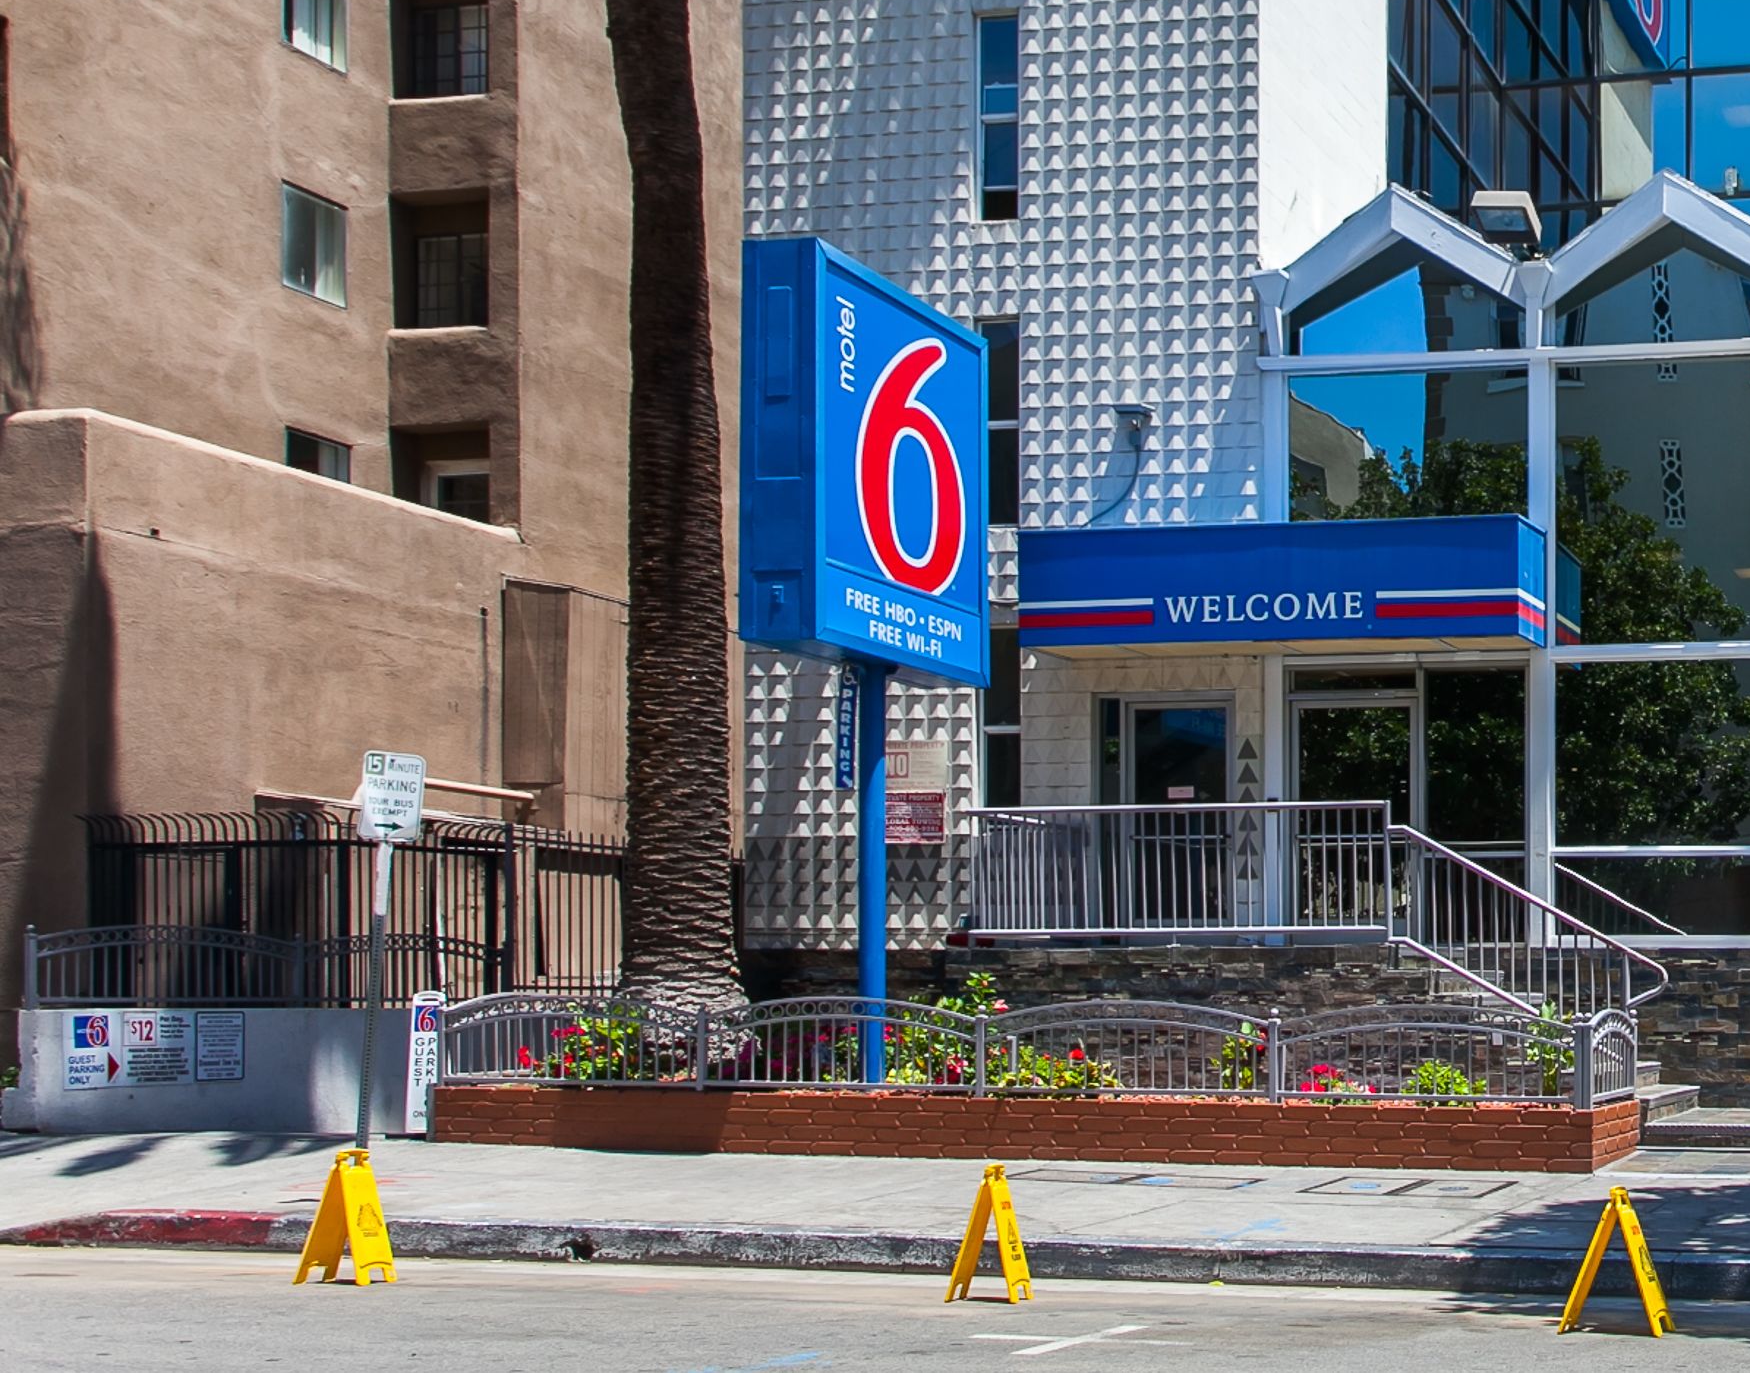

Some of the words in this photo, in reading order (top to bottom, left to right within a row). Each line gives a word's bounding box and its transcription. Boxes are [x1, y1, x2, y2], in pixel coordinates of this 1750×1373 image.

[836, 295, 856, 392] motel
[855, 337, 966, 596] 6
[846, 587, 881, 617] FREE
[885, 600, 916, 626] HBO
[928, 615, 962, 642] ESPN
[1164, 591, 1364, 623] WELCOME
[869, 619, 903, 646] FREE
[839, 688, 854, 771] PARKING
[367, 754, 383, 773] 15
[388, 761, 421, 775] MINUTE
[367, 776, 417, 794] PARKING
[394, 798, 414, 808] BUS
[86, 1015, 108, 1047] 6
[131, 1019, 153, 1041] $12
[418, 1007, 436, 1032] 6
[68, 1055, 96, 1064] GUEST
[68, 1064, 105, 1074] PARKING
[414, 1037, 425, 1087] GUEST
[426, 1037, 437, 1083] PARKI
[68, 1075, 91, 1084] ONLY
